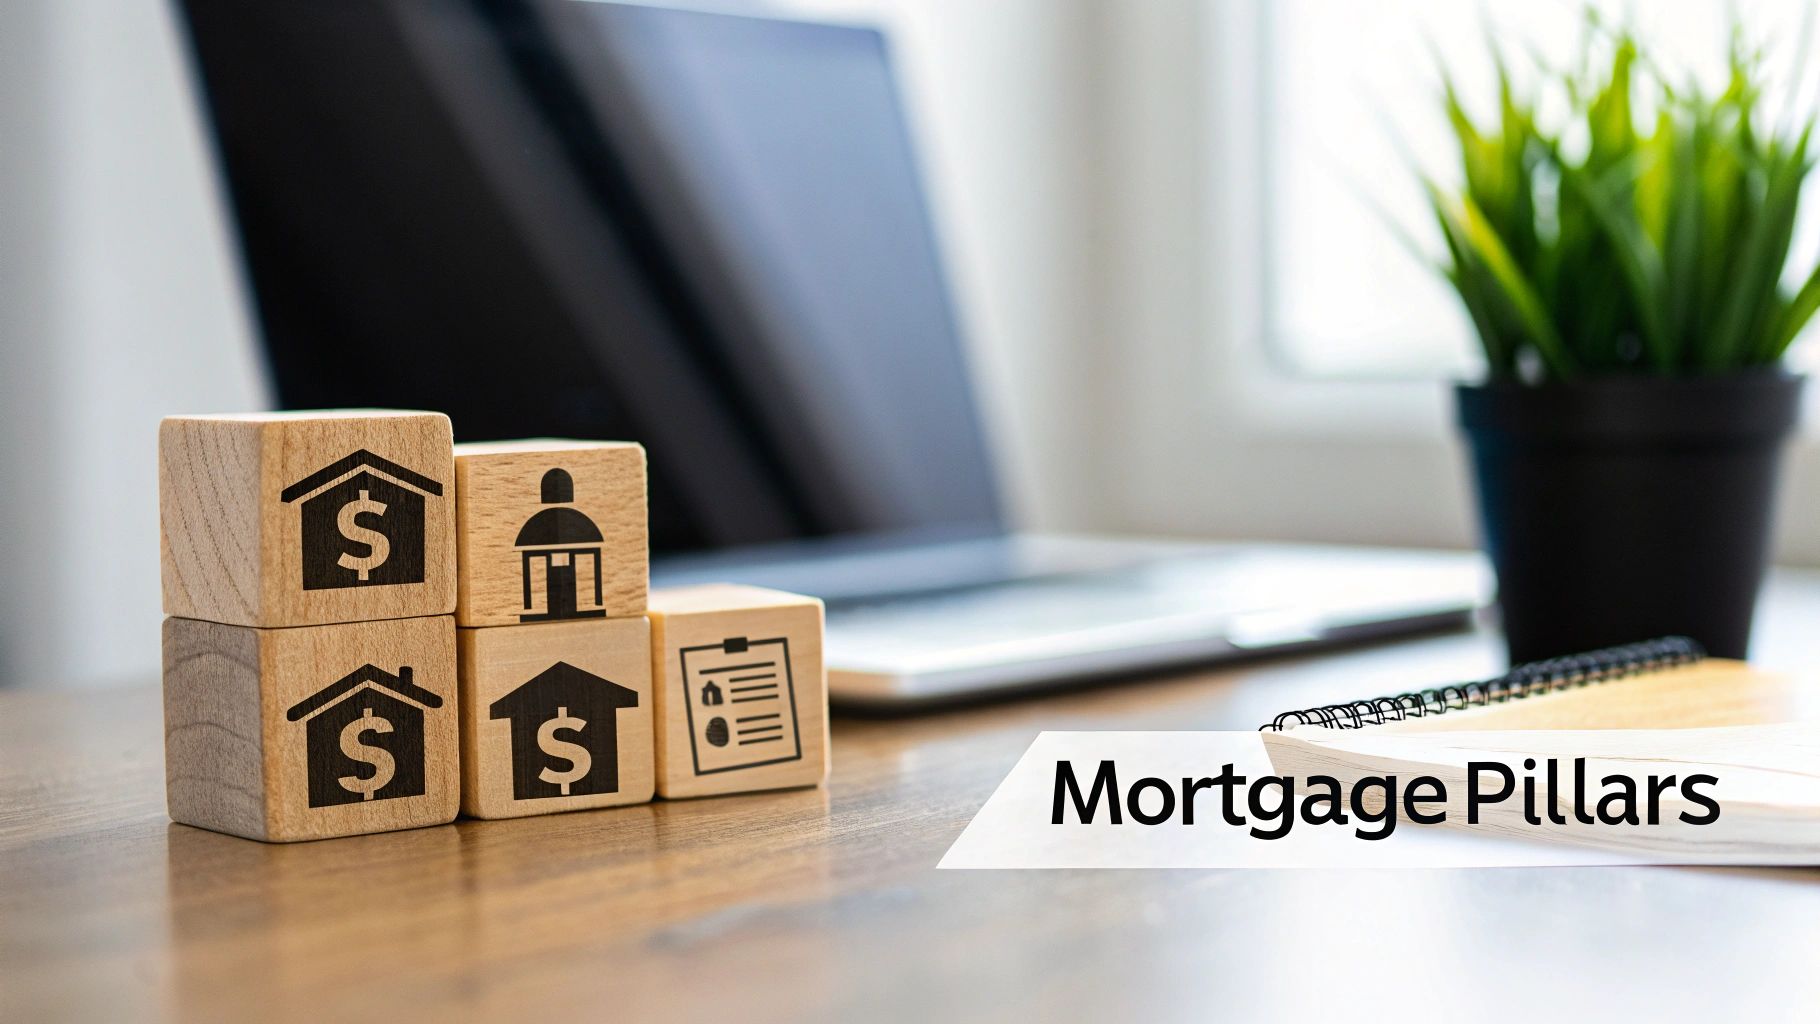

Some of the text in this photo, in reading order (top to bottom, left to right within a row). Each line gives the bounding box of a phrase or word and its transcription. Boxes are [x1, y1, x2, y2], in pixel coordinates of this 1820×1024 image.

[336, 490, 390, 580] $
[337, 707, 396, 801] $
[537, 706, 592, 795] $
